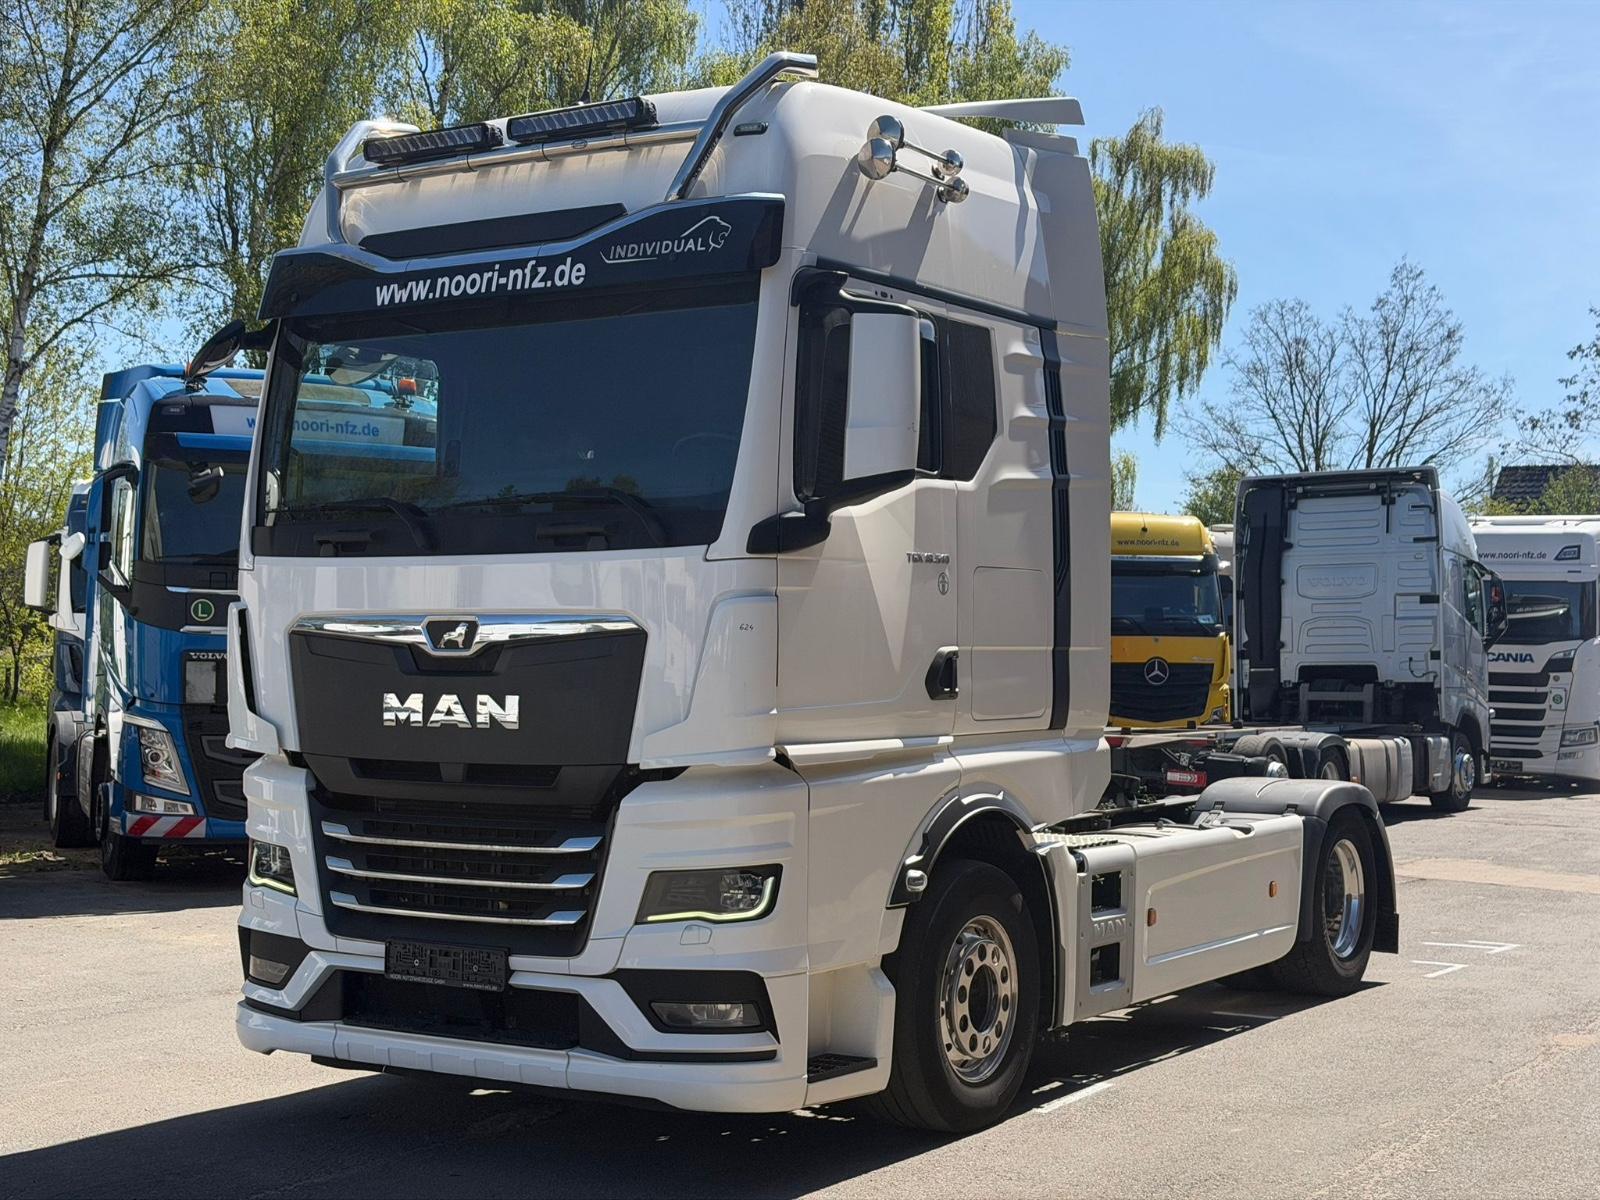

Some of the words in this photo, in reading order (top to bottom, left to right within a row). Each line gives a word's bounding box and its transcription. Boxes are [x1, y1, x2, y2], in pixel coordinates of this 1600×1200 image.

[609, 237, 706, 259] INDIVIDUAL
[375, 256, 586, 307] www.noori-nfz.de
[198, 602, 208, 617] L
[382, 692, 520, 730] MAN
